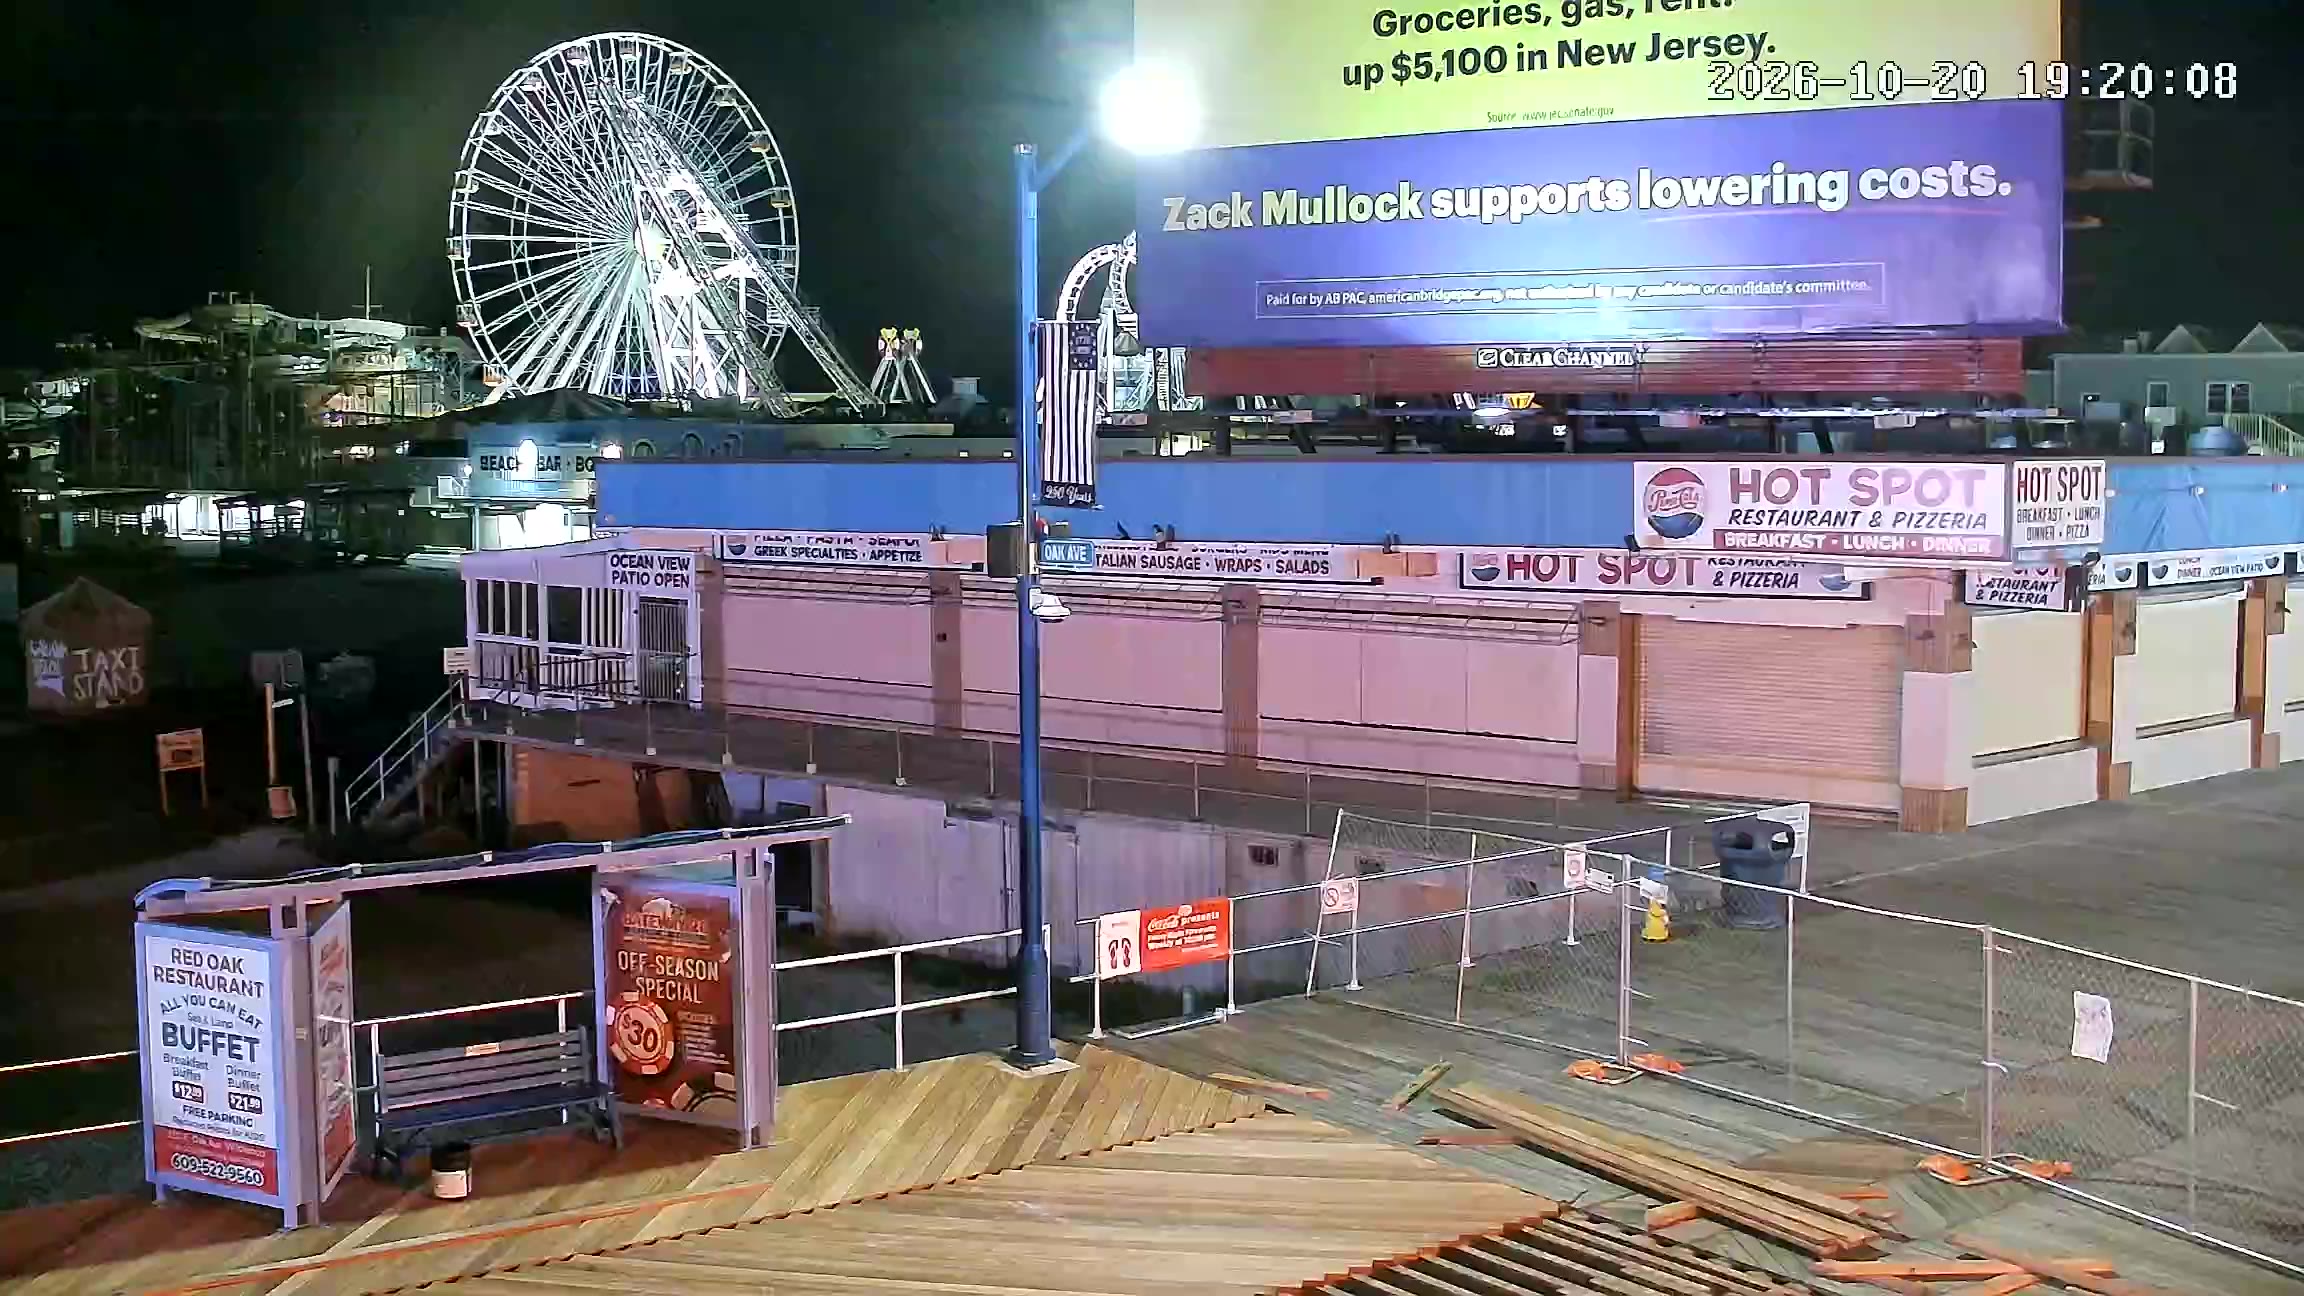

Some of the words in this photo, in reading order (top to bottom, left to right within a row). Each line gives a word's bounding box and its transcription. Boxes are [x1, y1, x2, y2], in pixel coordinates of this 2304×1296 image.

[1373, 0, 1551, 38] Groceries,
[1561, 0, 1635, 28] gas,
[1343, 61, 1384, 90] up
[1391, 45, 1507, 86] $5,100
[1516, 42, 1547, 72] in
[1558, 38, 1636, 68] New
[1645, 29, 1776, 63] Jersey.
[1163, 191, 1253, 232] Zack
[1262, 181, 1424, 226] Mullock
[1431, 177, 1631, 224] supports
[1637, 160, 1850, 213] lowering
[1858, 160, 2012, 201] costs.
[1266, 294, 1290, 306] Paid
[1292, 293, 1307, 305] for
[1309, 293, 1323, 307] by
[1325, 293, 1341, 305] AB
[1703, 284, 1718, 295] or
[1719, 280, 1793, 296] candidate's
[537, 455, 561, 472] BAR
[1729, 467, 1831, 505] HOT
[1848, 467, 1987, 508] SPOT
[2017, 467, 2051, 503] HOT
[2057, 466, 2102, 502] SPOT
[1727, 508, 1865, 529] RESTAURANT
[1868, 510, 1882, 529] &
[1891, 511, 1987, 530] PIZZERIA
[2016, 507, 2064, 524] BREAKFAST
[2074, 506, 2100, 521] LUNCH
[1723, 532, 1827, 550] BREAKFAST
[1843, 534, 1904, 551] LUNCH
[1922, 536, 1992, 555] DINNER
[2026, 525, 2055, 541] DINNER
[2066, 525, 2090, 539] PIZZA
[610, 553, 653, 569] OCEAN
[657, 555, 690, 571] VIEW
[754, 545, 788, 557] GREEK
[791, 546, 858, 560] SPECIALTIES
[1045, 544, 1066, 561] OAK
[1067, 545, 1087, 561] AVE
[1096, 553, 1136, 569] TALIAN
[1140, 555, 1201, 571] SAUSAGE
[1215, 558, 1262, 573] WRAPS
[1275, 560, 1330, 574] SALADS
[612, 570, 650, 585] PATIO
[654, 573, 690, 588] OPEN
[1508, 553, 1578, 582] HOT
[1598, 554, 1698, 586] SPOT
[1712, 571, 1723, 587] &
[1729, 571, 1800, 589] PIZZERIA
[1975, 589, 1984, 600] &
[1989, 590, 2048, 606] PIZZERIA
[71, 646, 139, 673] TAXI
[171, 947, 203, 967] RED
[207, 953, 244, 975] OAK
[617, 950, 720, 982] OFF-SEASON
[153, 965, 264, 998] RESTAURANT
[635, 977, 703, 1004] SPECIAL
[160, 997, 182, 1015] ALL
[182, 994, 206, 1007] YOU
[209, 998, 236, 1014] CAN
[238, 1008, 263, 1029] EAT
[162, 1022, 260, 1063] BUFFET
[622, 1014, 658, 1052] $30
[183, 1105, 207, 1119] FREE
[208, 1111, 253, 1128] PARKING
